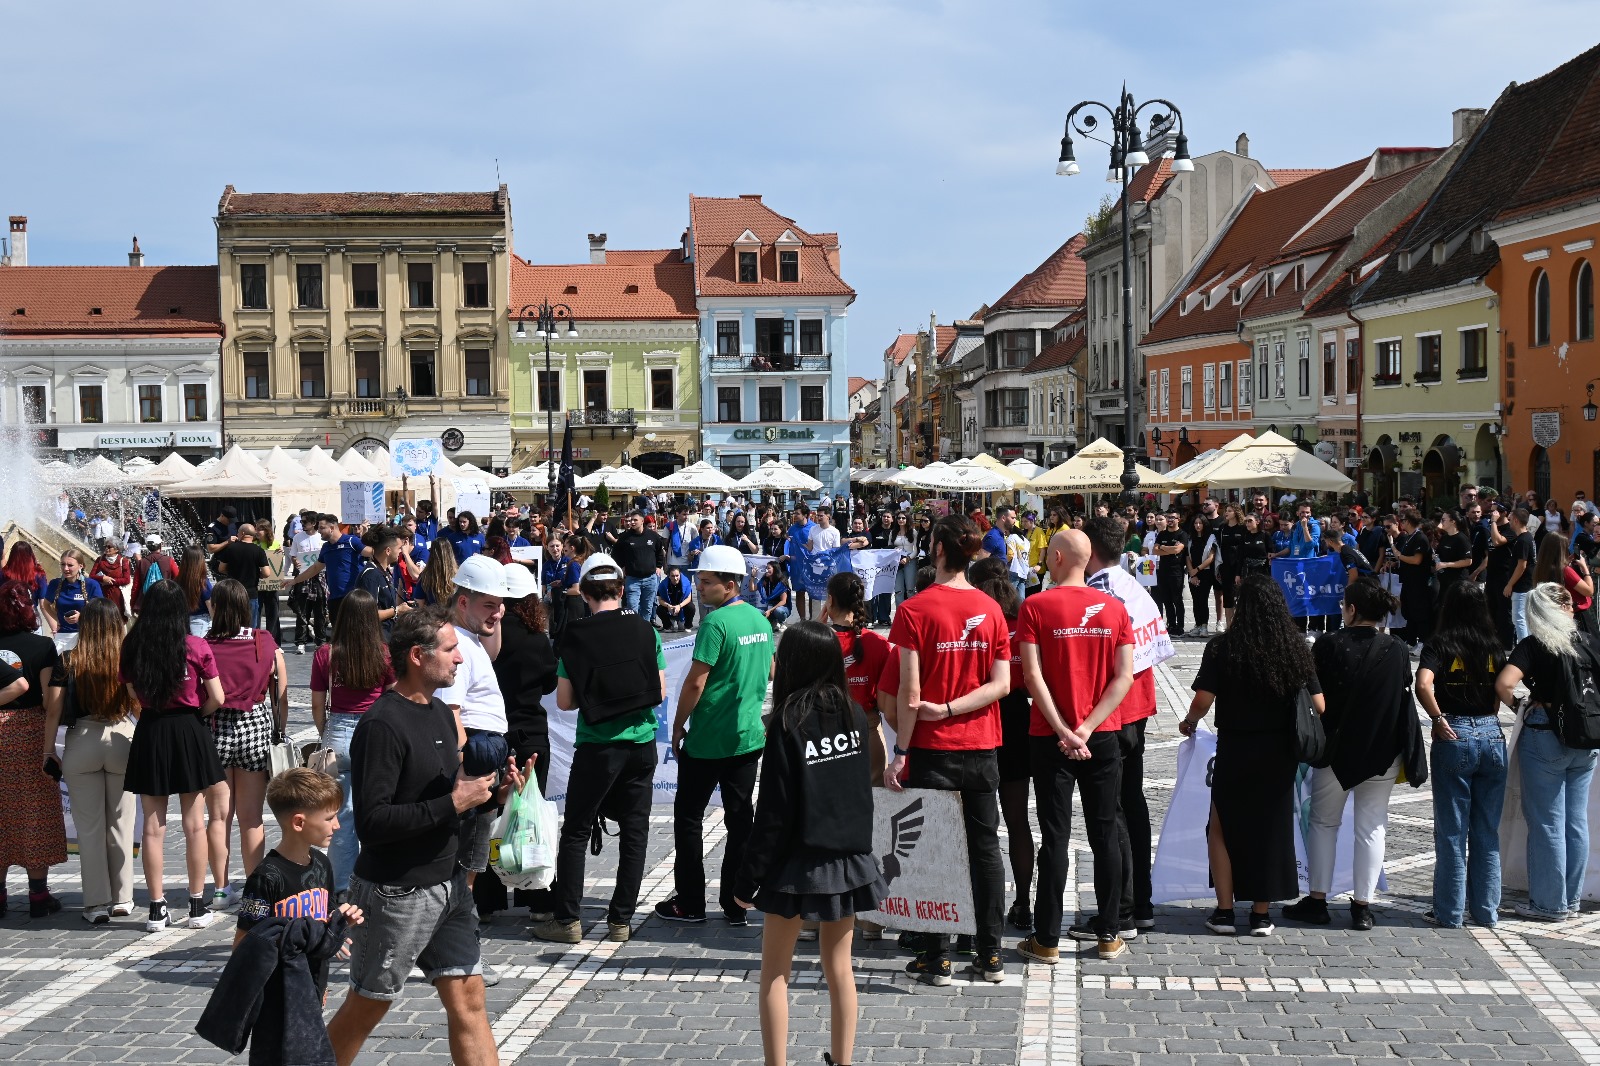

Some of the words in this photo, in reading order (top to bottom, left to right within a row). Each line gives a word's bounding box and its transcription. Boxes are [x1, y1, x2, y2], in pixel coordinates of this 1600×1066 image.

[733, 428, 760, 439] CEC
[779, 427, 815, 439] Bank
[100, 436, 169, 445] RESTAURANT
[1089, 627, 1112, 635] HERMES
[915, 899, 960, 923] HERMES
